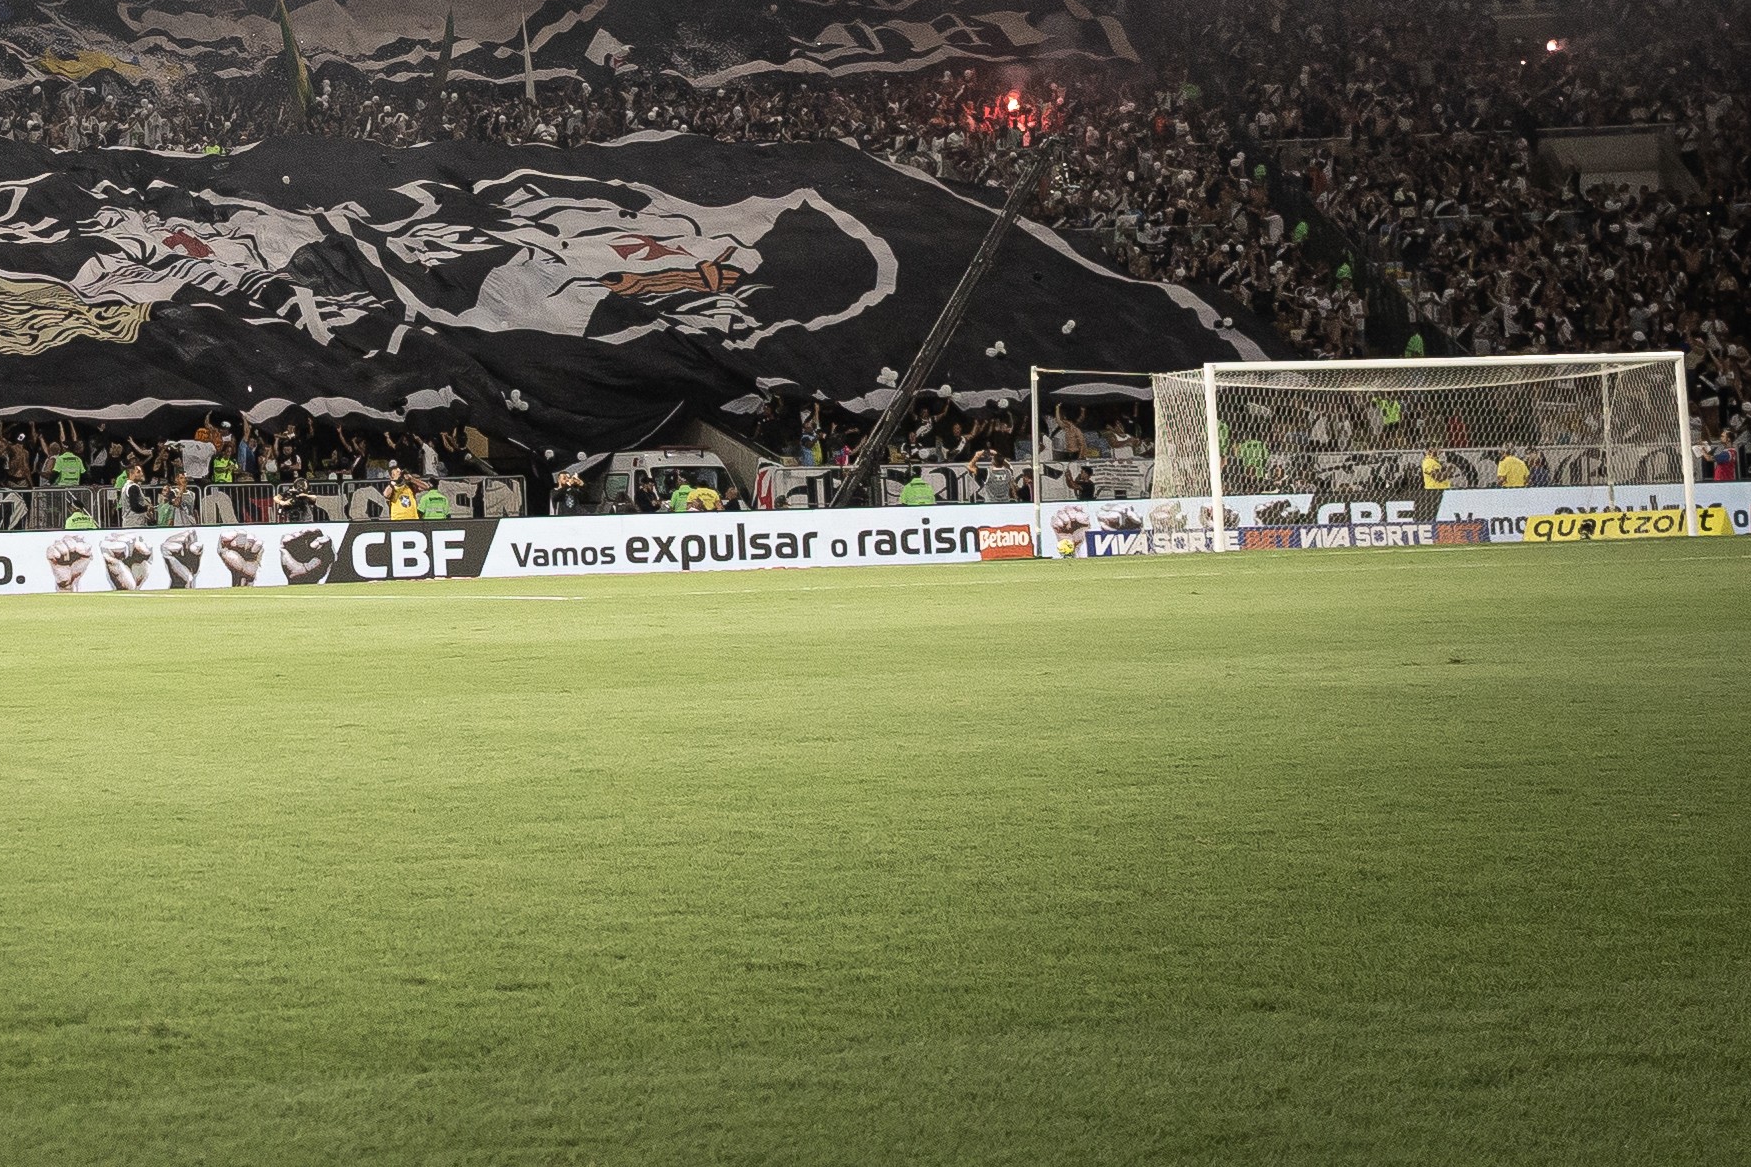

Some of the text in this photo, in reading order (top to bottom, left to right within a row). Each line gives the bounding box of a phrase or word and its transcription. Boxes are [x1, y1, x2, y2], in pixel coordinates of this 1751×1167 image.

[1300, 527, 1350, 548] VIVA
[1353, 524, 1433, 546] SORTE
[1533, 509, 1715, 541] quartzolt
[352, 530, 465, 578] CBF
[511, 543, 615, 567] Vamos
[626, 523, 817, 570] expulsar
[831, 539, 847, 557] o
[980, 530, 1030, 550] Betano
[1094, 532, 1149, 557] VIVA
